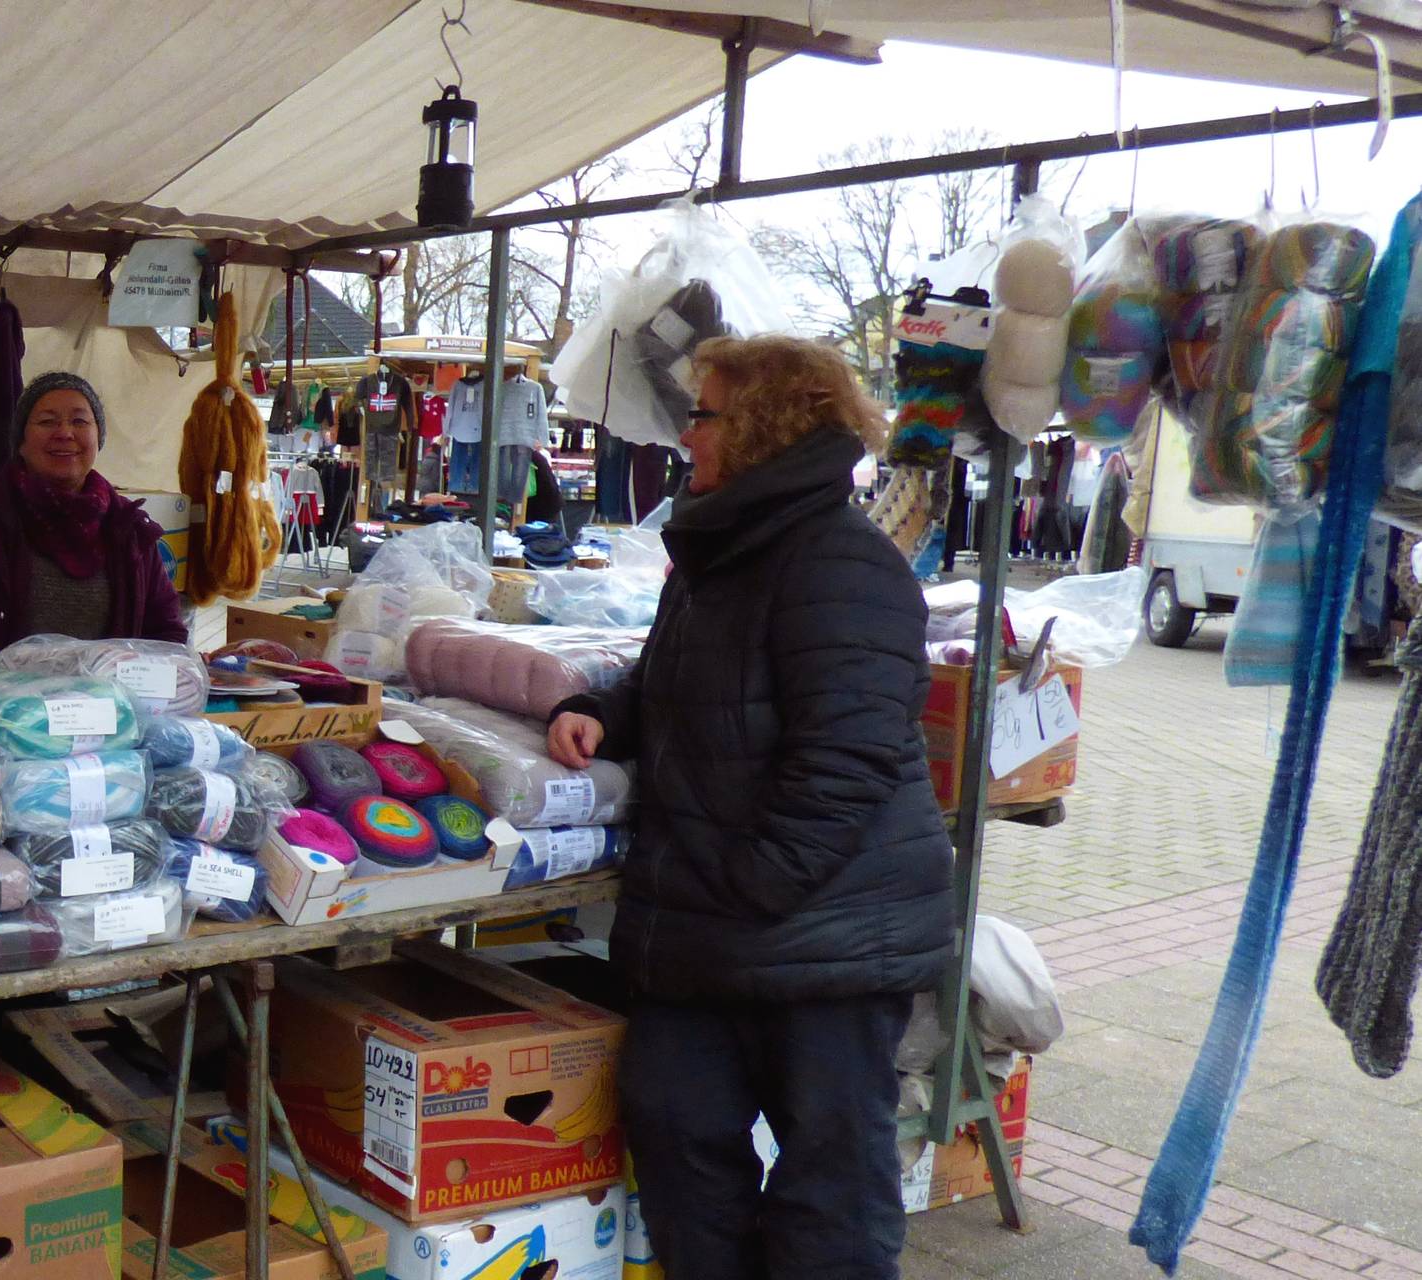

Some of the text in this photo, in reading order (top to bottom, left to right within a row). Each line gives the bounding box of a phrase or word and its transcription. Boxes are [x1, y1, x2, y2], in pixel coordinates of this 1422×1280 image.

[209, 863, 222, 873] SEA
[223, 866, 243, 878] SHELL
[423, 1055, 492, 1095] Dole
[423, 1097, 487, 1116] CLASS EXTRA
[425, 1175, 523, 1209] PREMIUM
[530, 1156, 618, 1191] BANANAS
[31, 1210, 108, 1242] Premium
